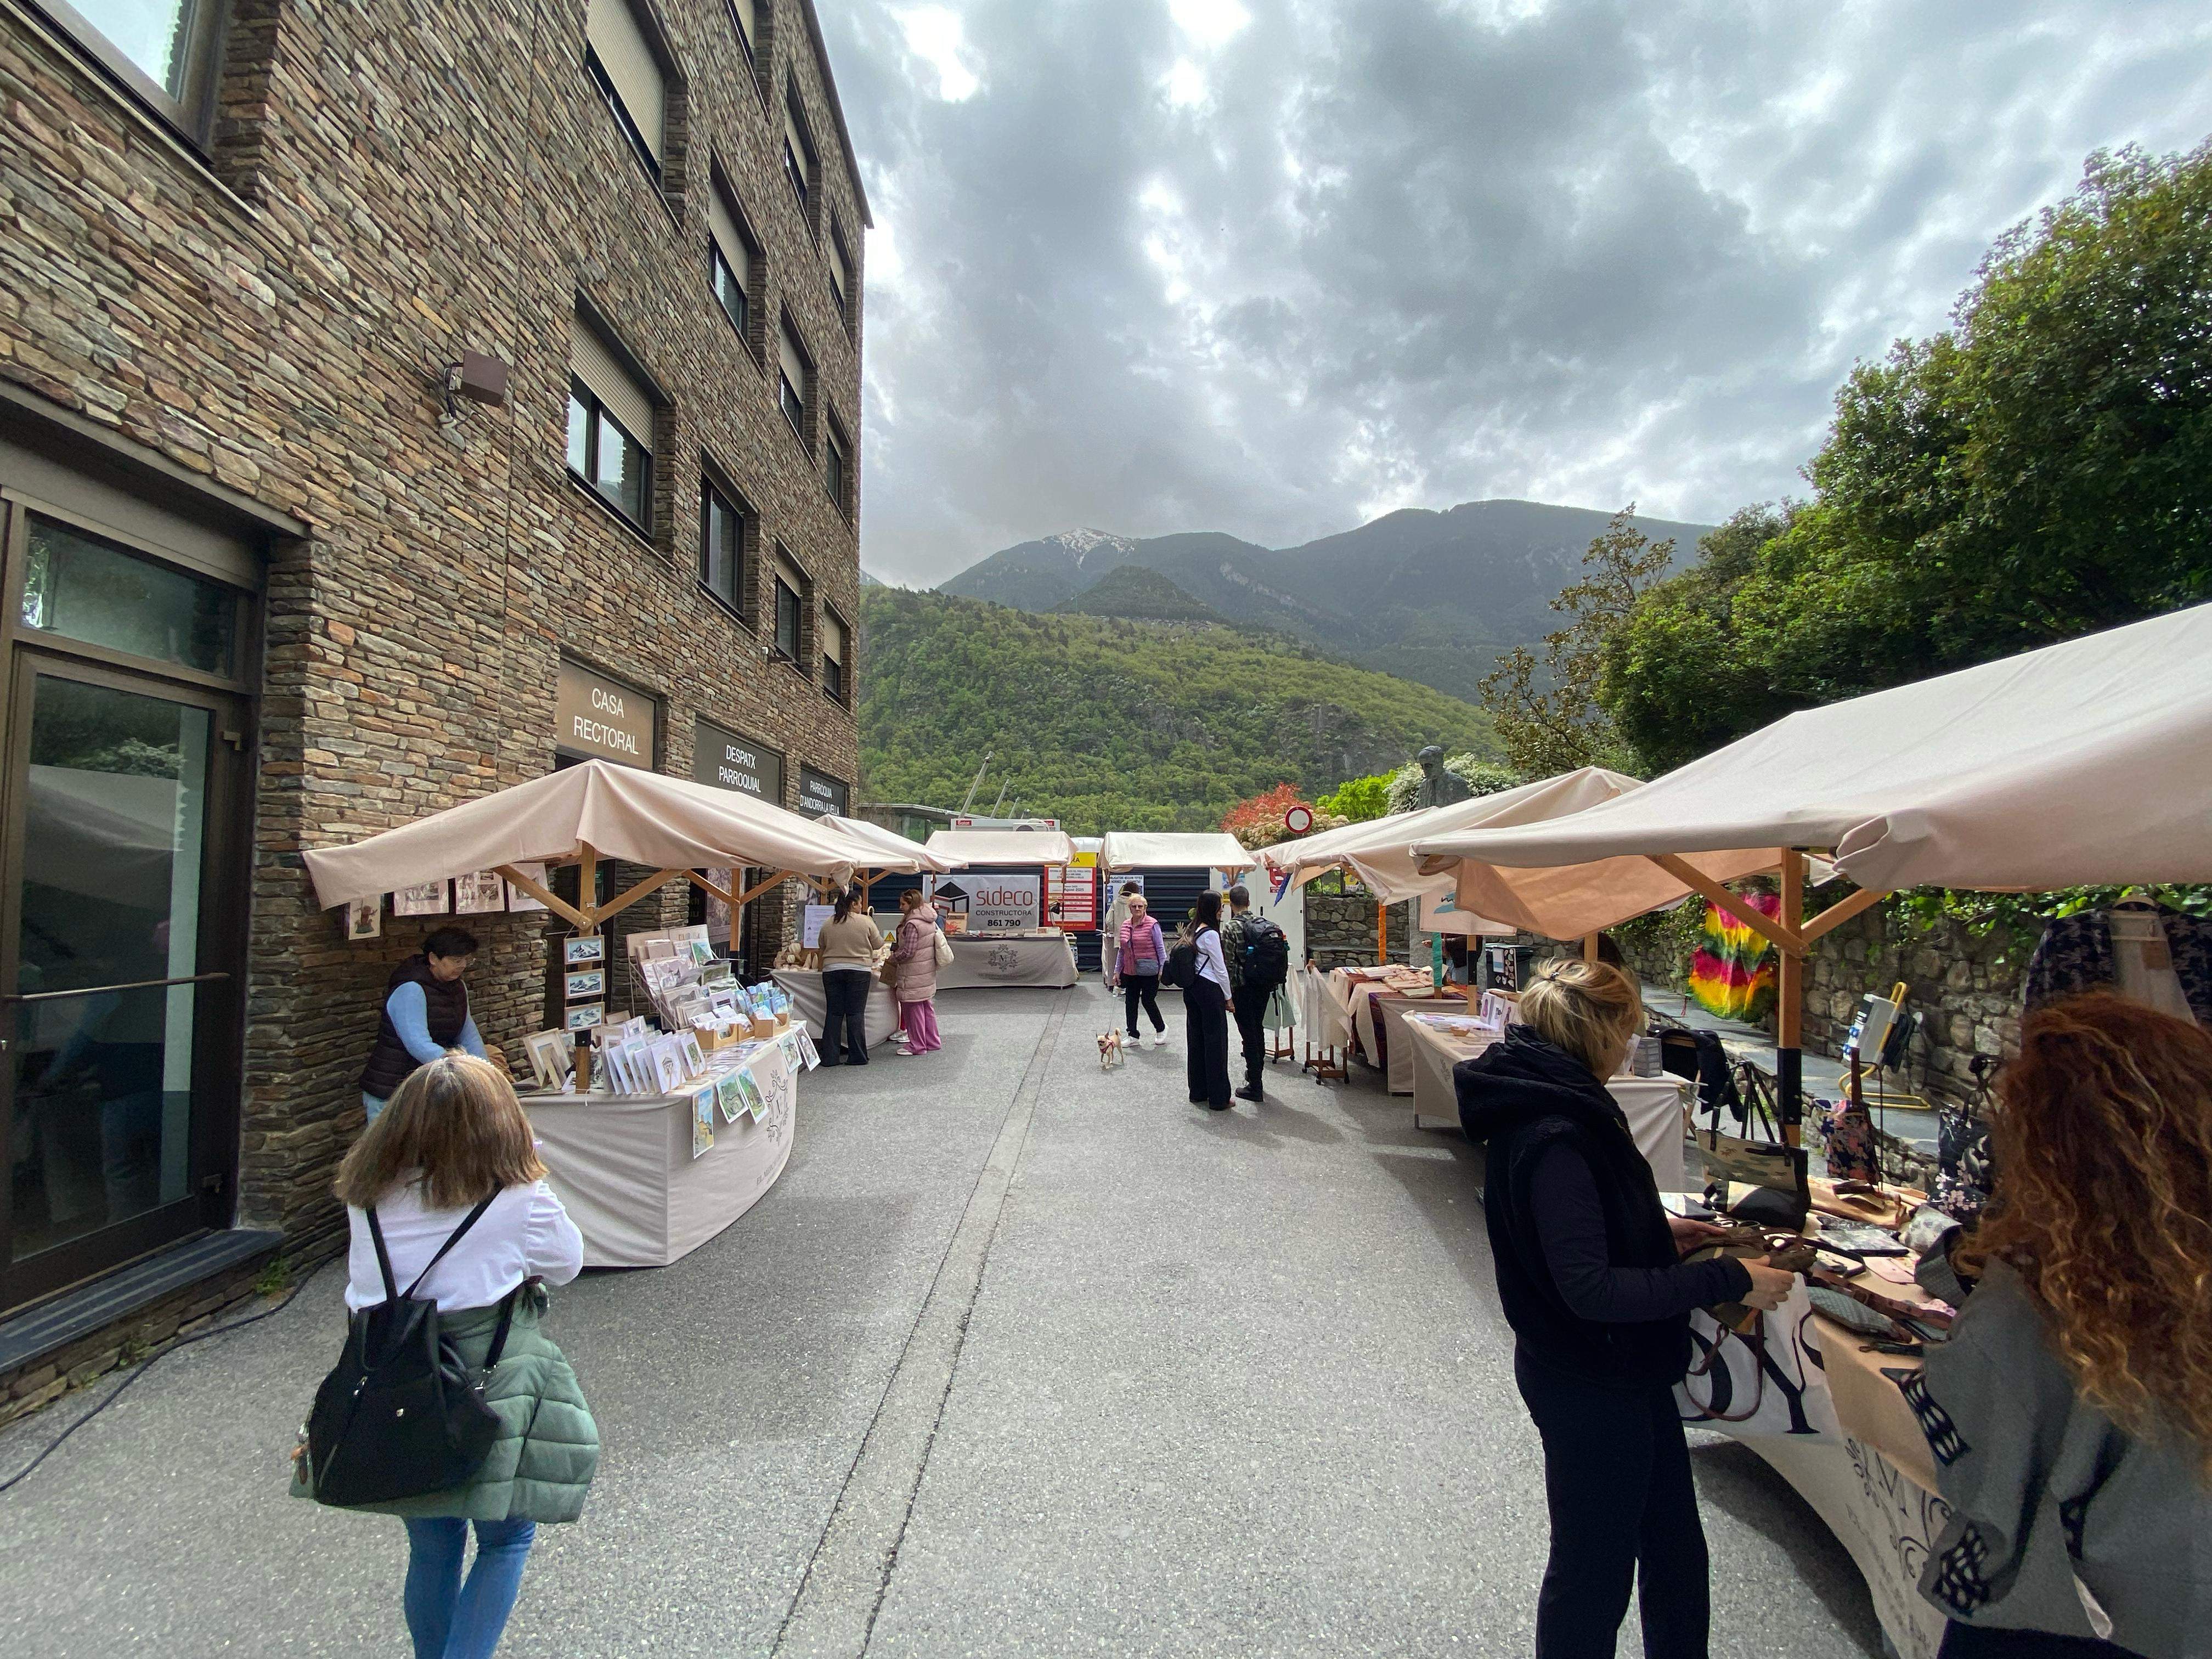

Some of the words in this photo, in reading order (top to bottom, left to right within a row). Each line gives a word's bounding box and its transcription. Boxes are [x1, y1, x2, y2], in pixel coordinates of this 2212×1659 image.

[591, 687, 624, 718] CASA
[573, 715, 639, 755] RECTORAL
[726, 744, 756, 769] DESPATX
[719, 765, 761, 793] PARROQUIAL
[810, 780, 832, 799] PARRÒQUIA
[800, 794, 824, 811] D'ANDORRA
[824, 801, 829, 813] LA
[829, 803, 840, 816] VELLA
[976, 885, 1033, 906] sideco
